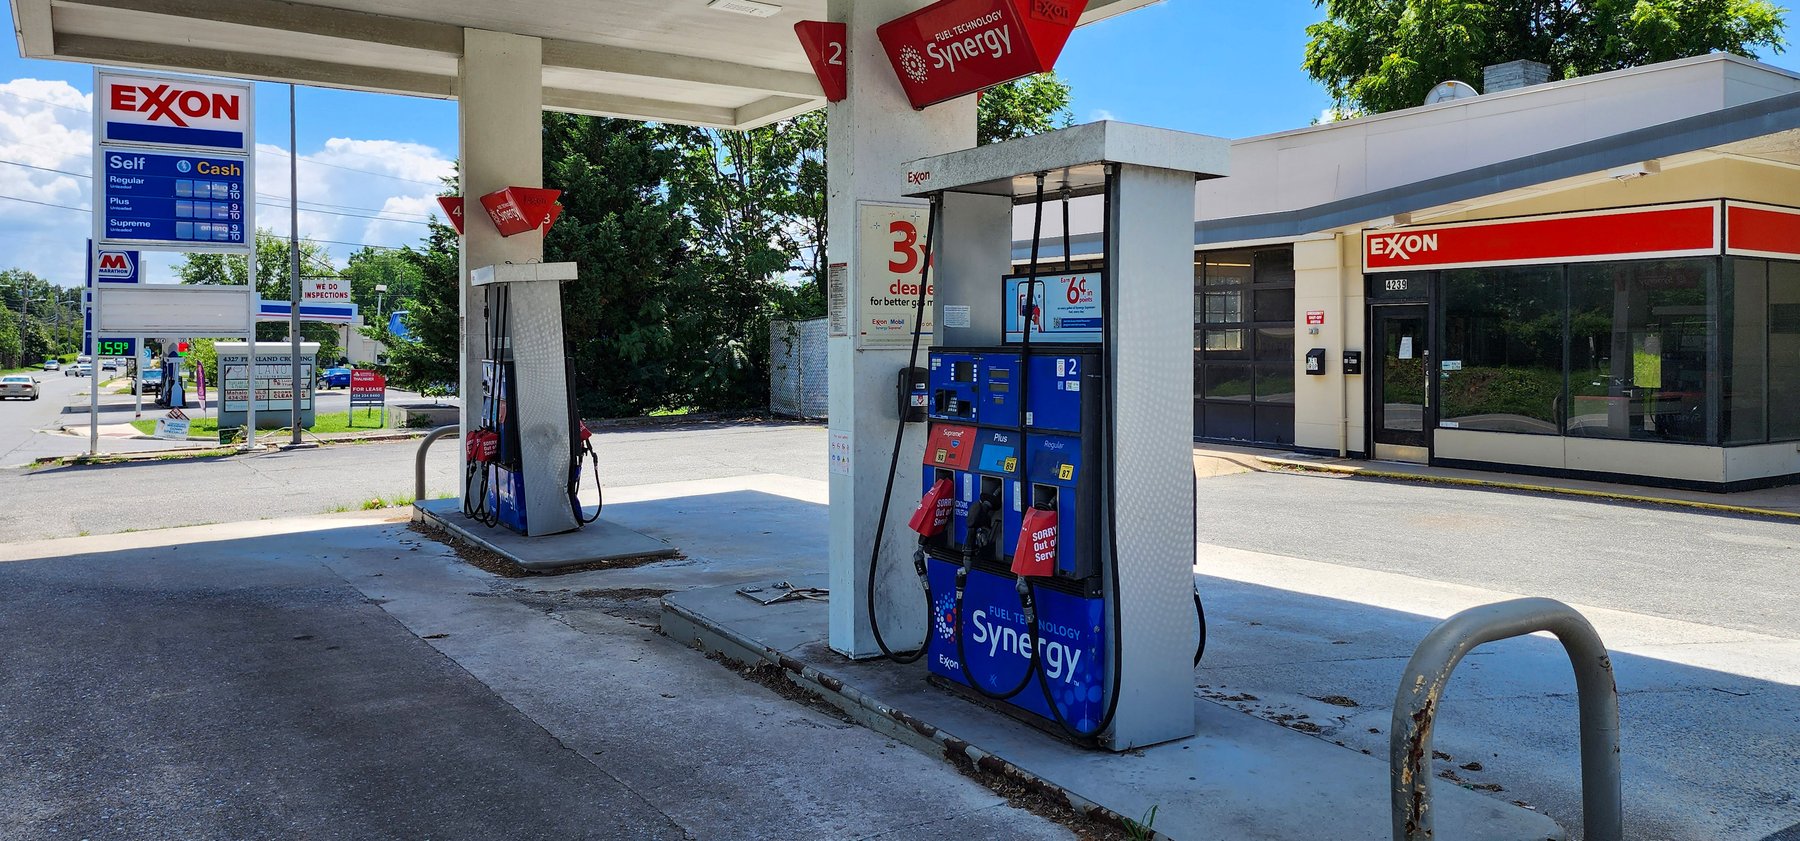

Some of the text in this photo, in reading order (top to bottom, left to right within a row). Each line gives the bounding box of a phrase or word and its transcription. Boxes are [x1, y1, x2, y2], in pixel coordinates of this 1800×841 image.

[935, 10, 1002, 42] FUEL TECHNOLOGY
[828, 42, 842, 65] 2
[926, 24, 1012, 73] Synergy
[111, 84, 239, 127] EXXON
[110, 156, 241, 176] Self Cash
[110, 175, 145, 185] Regular
[908, 170, 930, 185] Exxon
[110, 197, 130, 205] Plus
[452, 205, 462, 216] 4
[110, 219, 151, 228] Supreme
[543, 213, 551, 224] 3
[1371, 233, 1438, 260] EXXON
[890, 279, 933, 296] cleae
[1386, 280, 1407, 290] 4239
[870, 296, 882, 306] for
[884, 296, 910, 306] better
[1068, 358, 1076, 375] 2
[994, 432, 1008, 442] Plus
[1044, 440, 1064, 450] Regular
[1006, 462, 1014, 470] 89
[1062, 470, 1070, 478] 87
[1032, 526, 1056, 542] SORRY
[1034, 540, 1048, 552] Out
[989, 606, 1080, 640] FUEL TENOLOGY
[973, 610, 1081, 684] Synergy
[939, 654, 959, 670] Exxon
